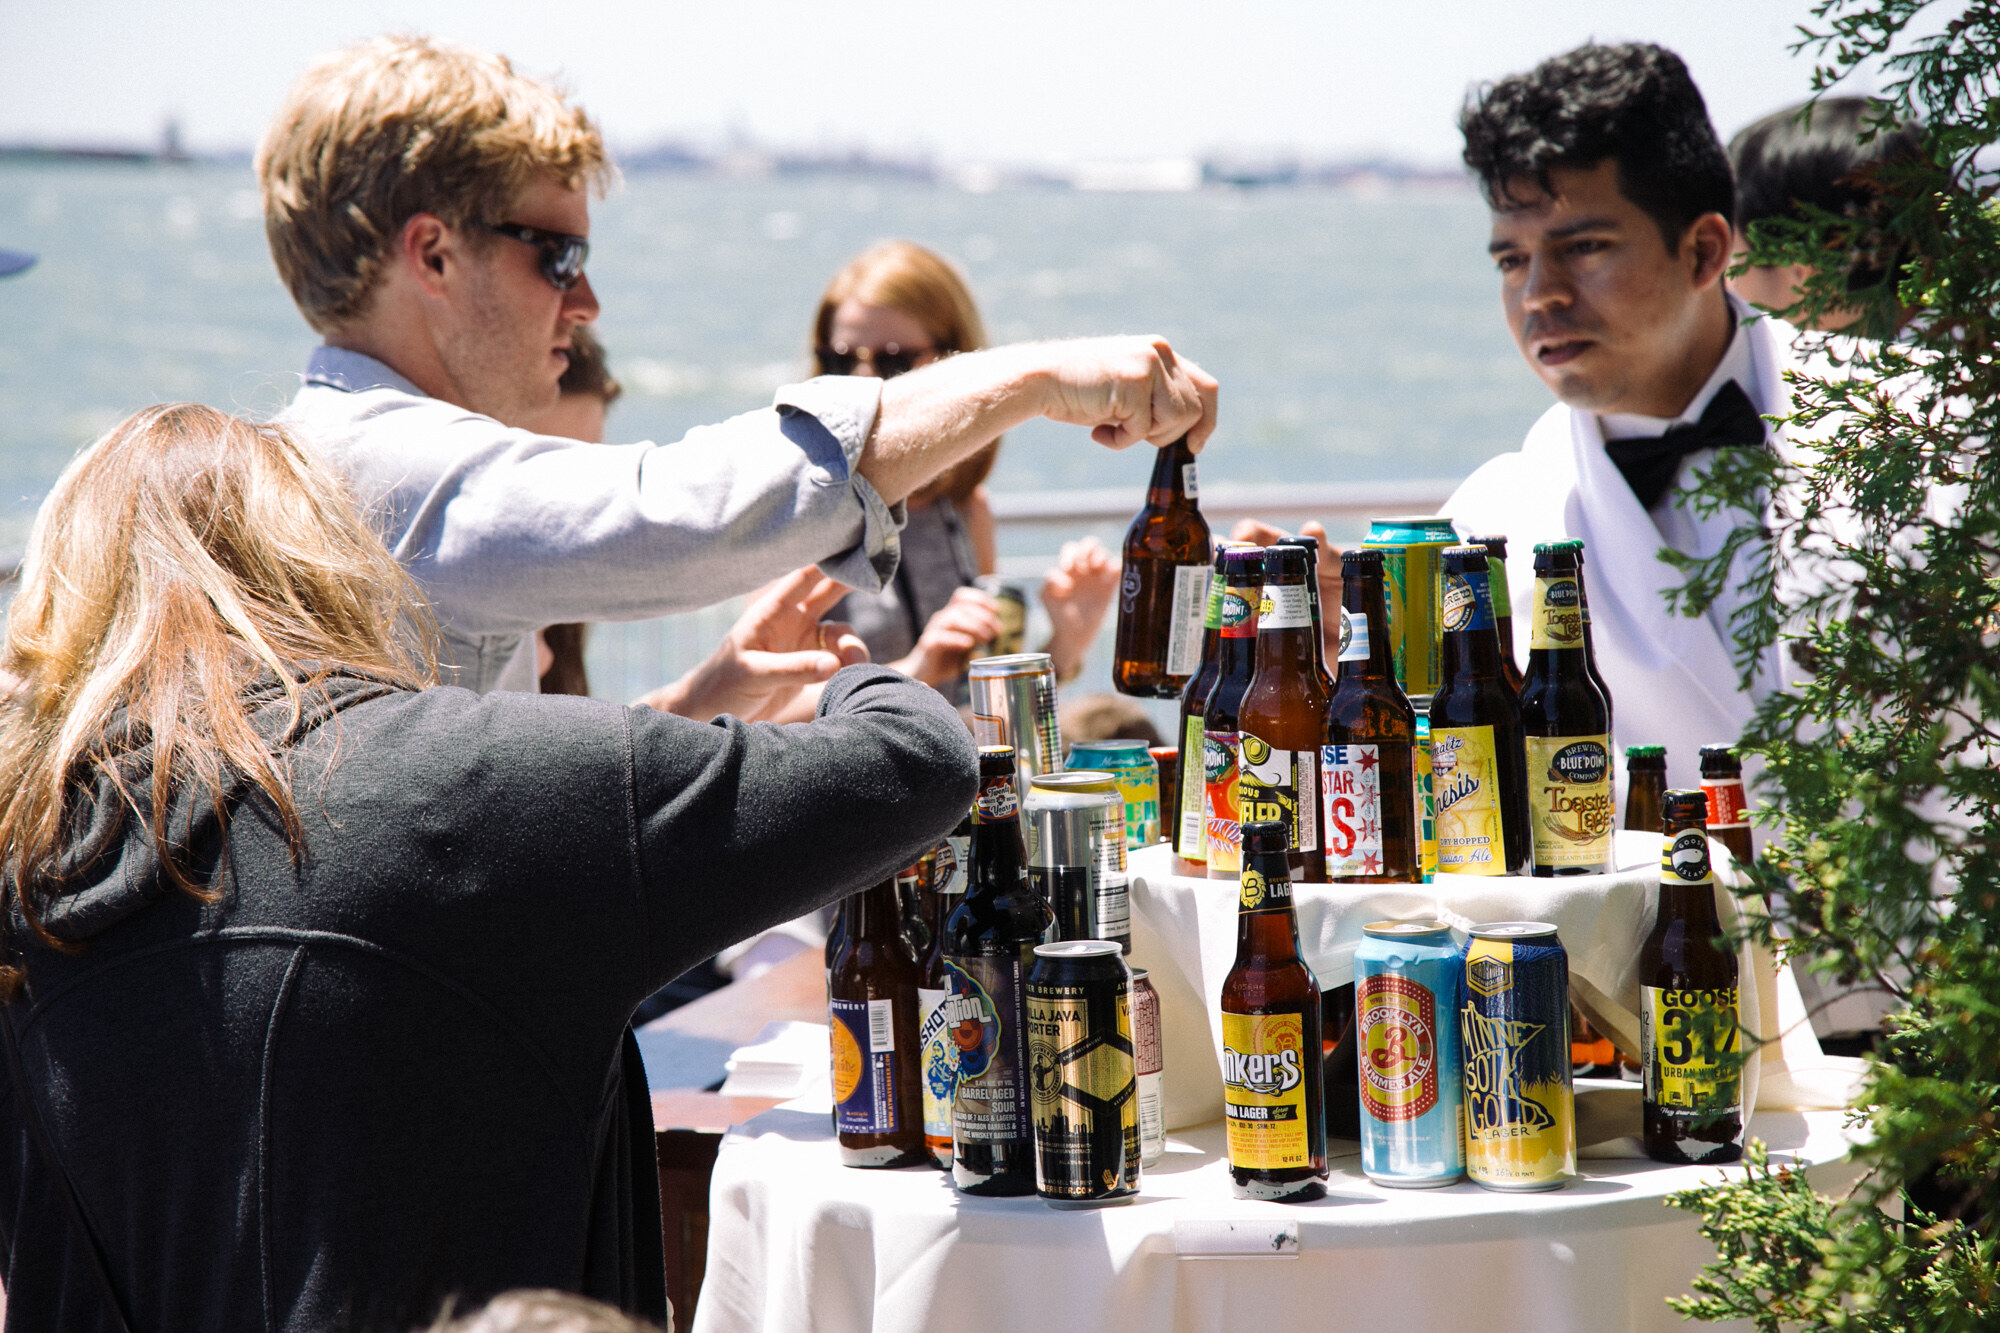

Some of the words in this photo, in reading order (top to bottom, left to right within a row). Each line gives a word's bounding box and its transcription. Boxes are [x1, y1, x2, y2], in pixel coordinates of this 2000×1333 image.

[1565, 744, 1602, 756] BREWING
[1560, 757, 1583, 770] BLUE
[1585, 754, 1605, 769] POINT
[1568, 771, 1601, 780] COMPANY
[1322, 770, 1355, 795] STAR
[987, 783, 1011, 797] Twenty
[990, 804, 1012, 817] Years
[1440, 838, 1452, 846] DRY
[1453, 836, 1491, 846] HOPPED
[1678, 838, 1706, 849] GOOSE
[1468, 848, 1493, 863] Ale
[1678, 865, 1707, 878] ISLAND
[1038, 986, 1085, 995] BREWERY
[1661, 988, 1738, 1008] GOOSE
[1049, 1010, 1082, 1022] JAVA
[1361, 1006, 1426, 1037] BROOKLYN
[1224, 1049, 1302, 1093] nkers
[1361, 1054, 1408, 1090] SUMMER
[1408, 1057, 1429, 1086] ALE
[1465, 1049, 1517, 1099] SOTA
[962, 1087, 990, 1100] BARREL
[992, 1088, 1015, 1100] AGED
[991, 1101, 1016, 1113] SOUR
[1239, 1106, 1268, 1120] LAGER
[1470, 1094, 1538, 1133] GOLD
[987, 1123, 1011, 1131] BARRELS
[1484, 1127, 1531, 1140] LAGER
[993, 1131, 1018, 1139] BARRELS
